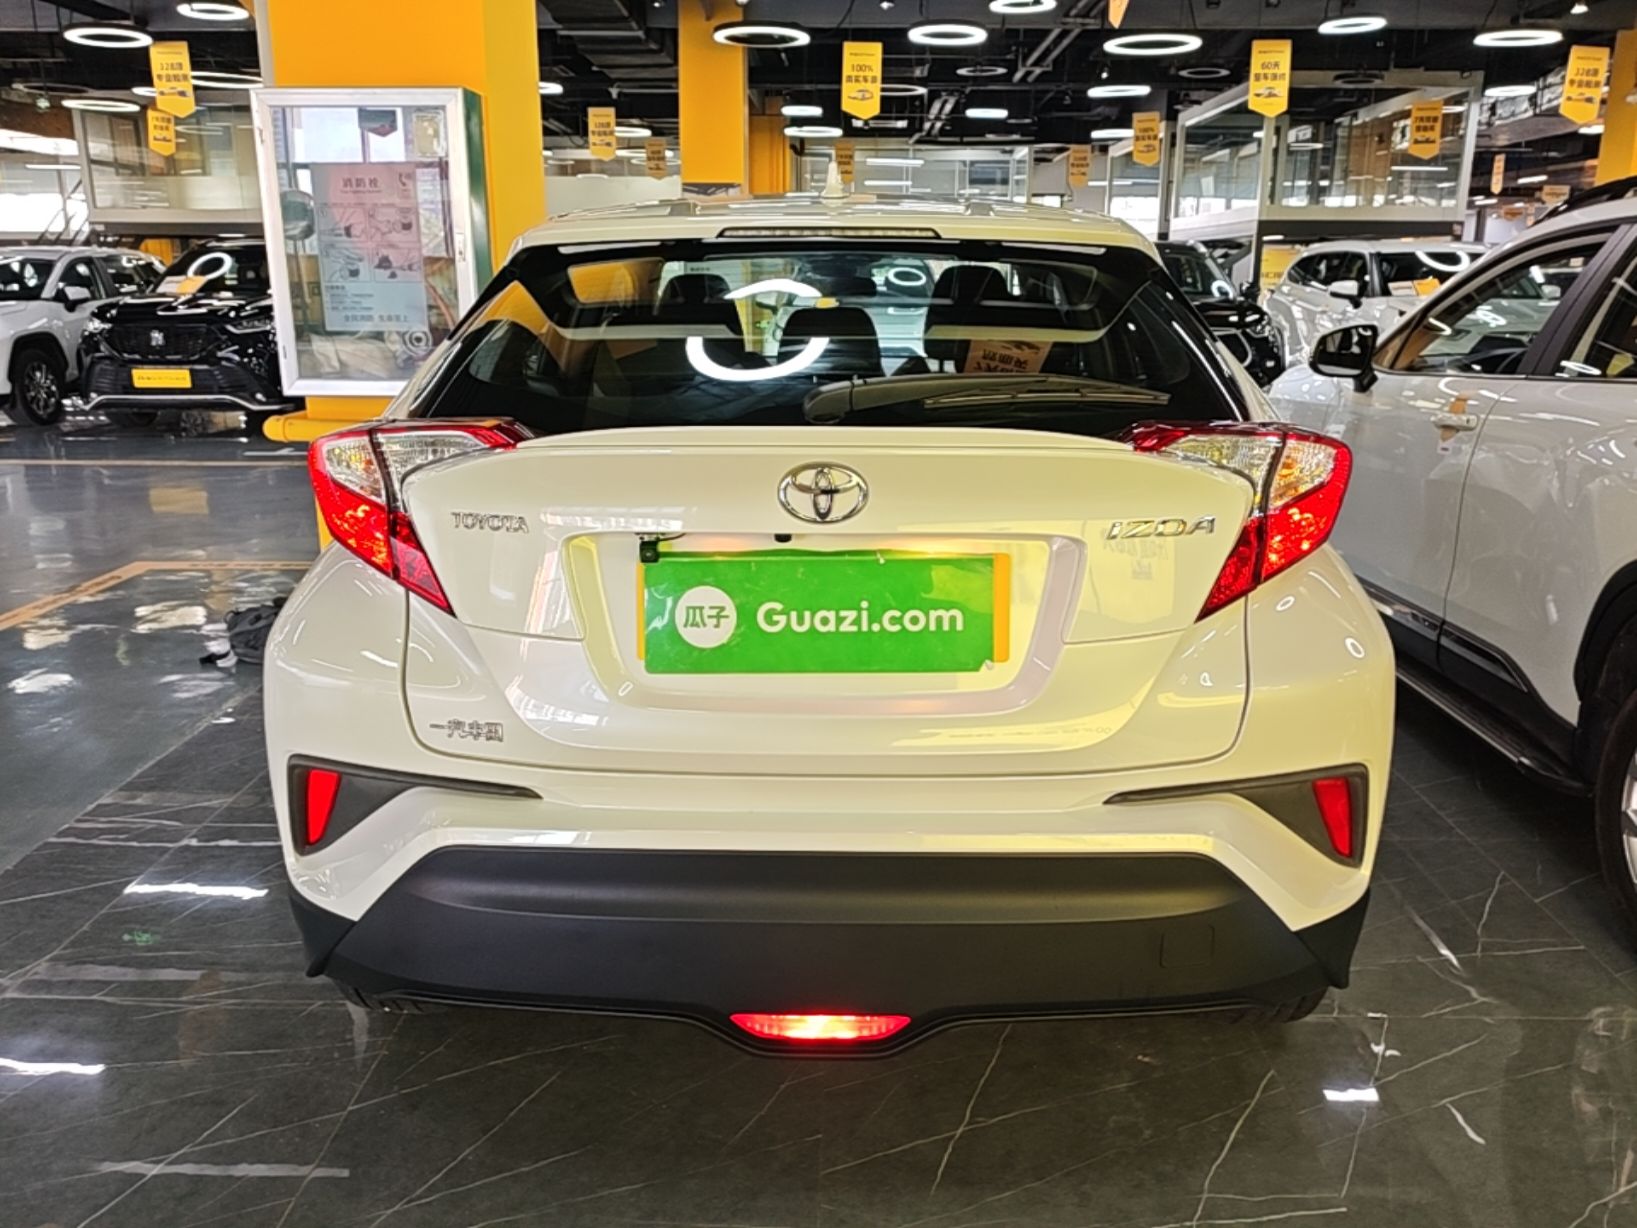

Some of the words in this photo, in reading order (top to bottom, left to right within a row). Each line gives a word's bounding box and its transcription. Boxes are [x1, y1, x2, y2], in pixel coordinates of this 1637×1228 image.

[851, 63, 874, 73] 100%
[450, 511, 530, 534] TOYOTA
[1105, 514, 1216, 541] IZOA
[682, 604, 731, 630] 瓜子
[756, 600, 965, 634] Guazi.com
